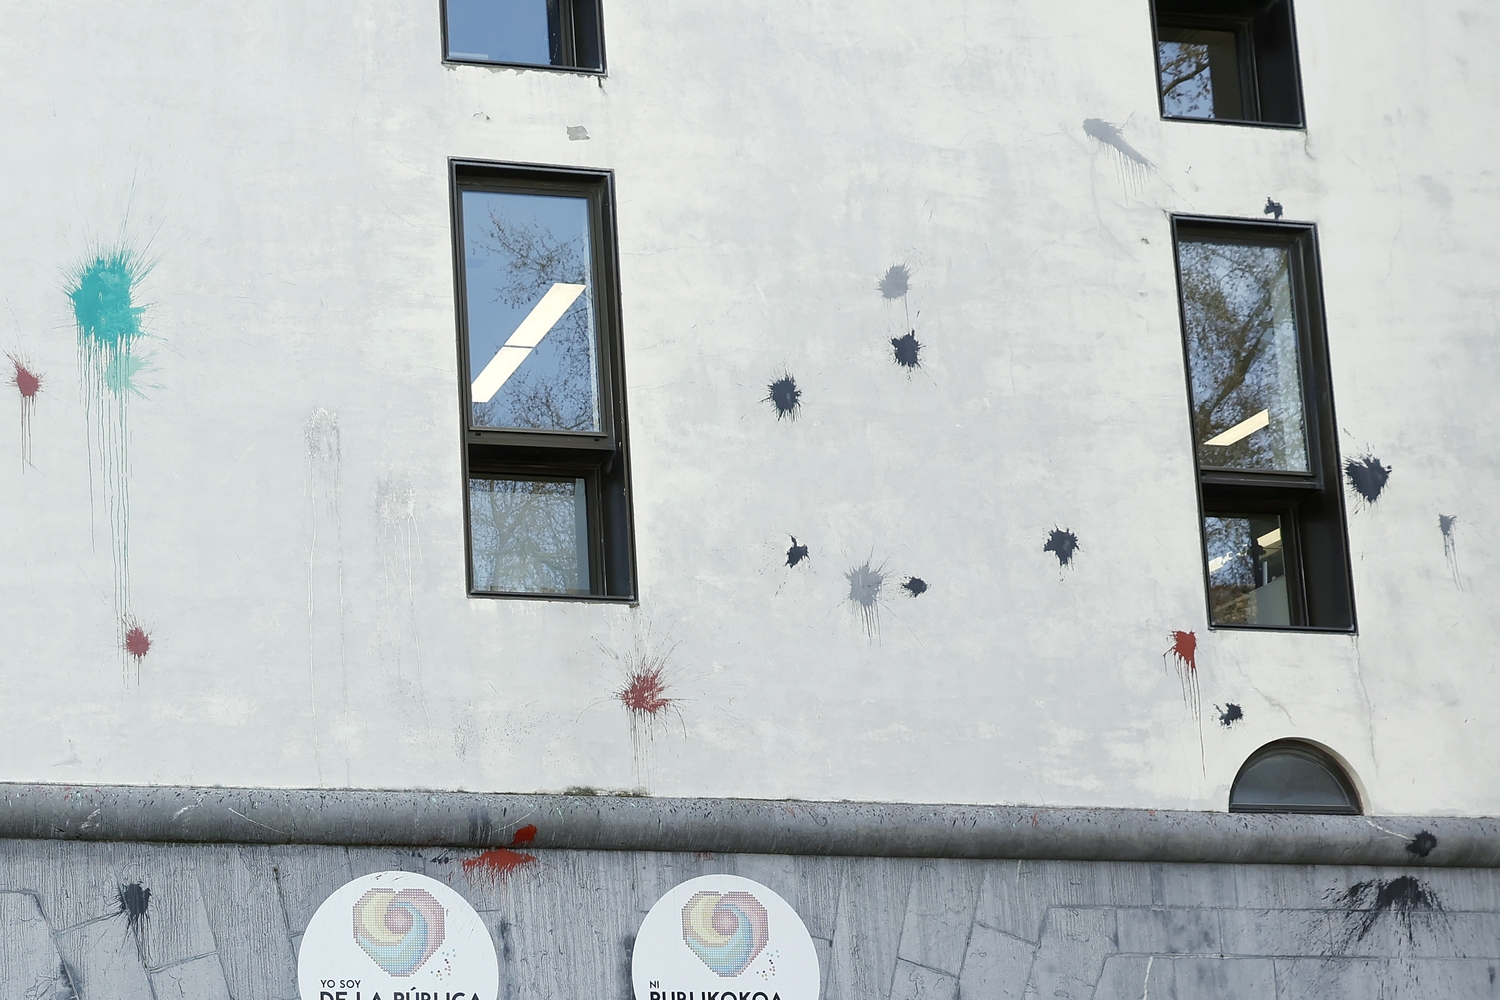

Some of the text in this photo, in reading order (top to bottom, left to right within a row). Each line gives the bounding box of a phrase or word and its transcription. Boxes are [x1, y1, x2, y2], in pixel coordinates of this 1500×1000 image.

[320, 979, 361, 989] YO SOY
[649, 980, 660, 989] NI
